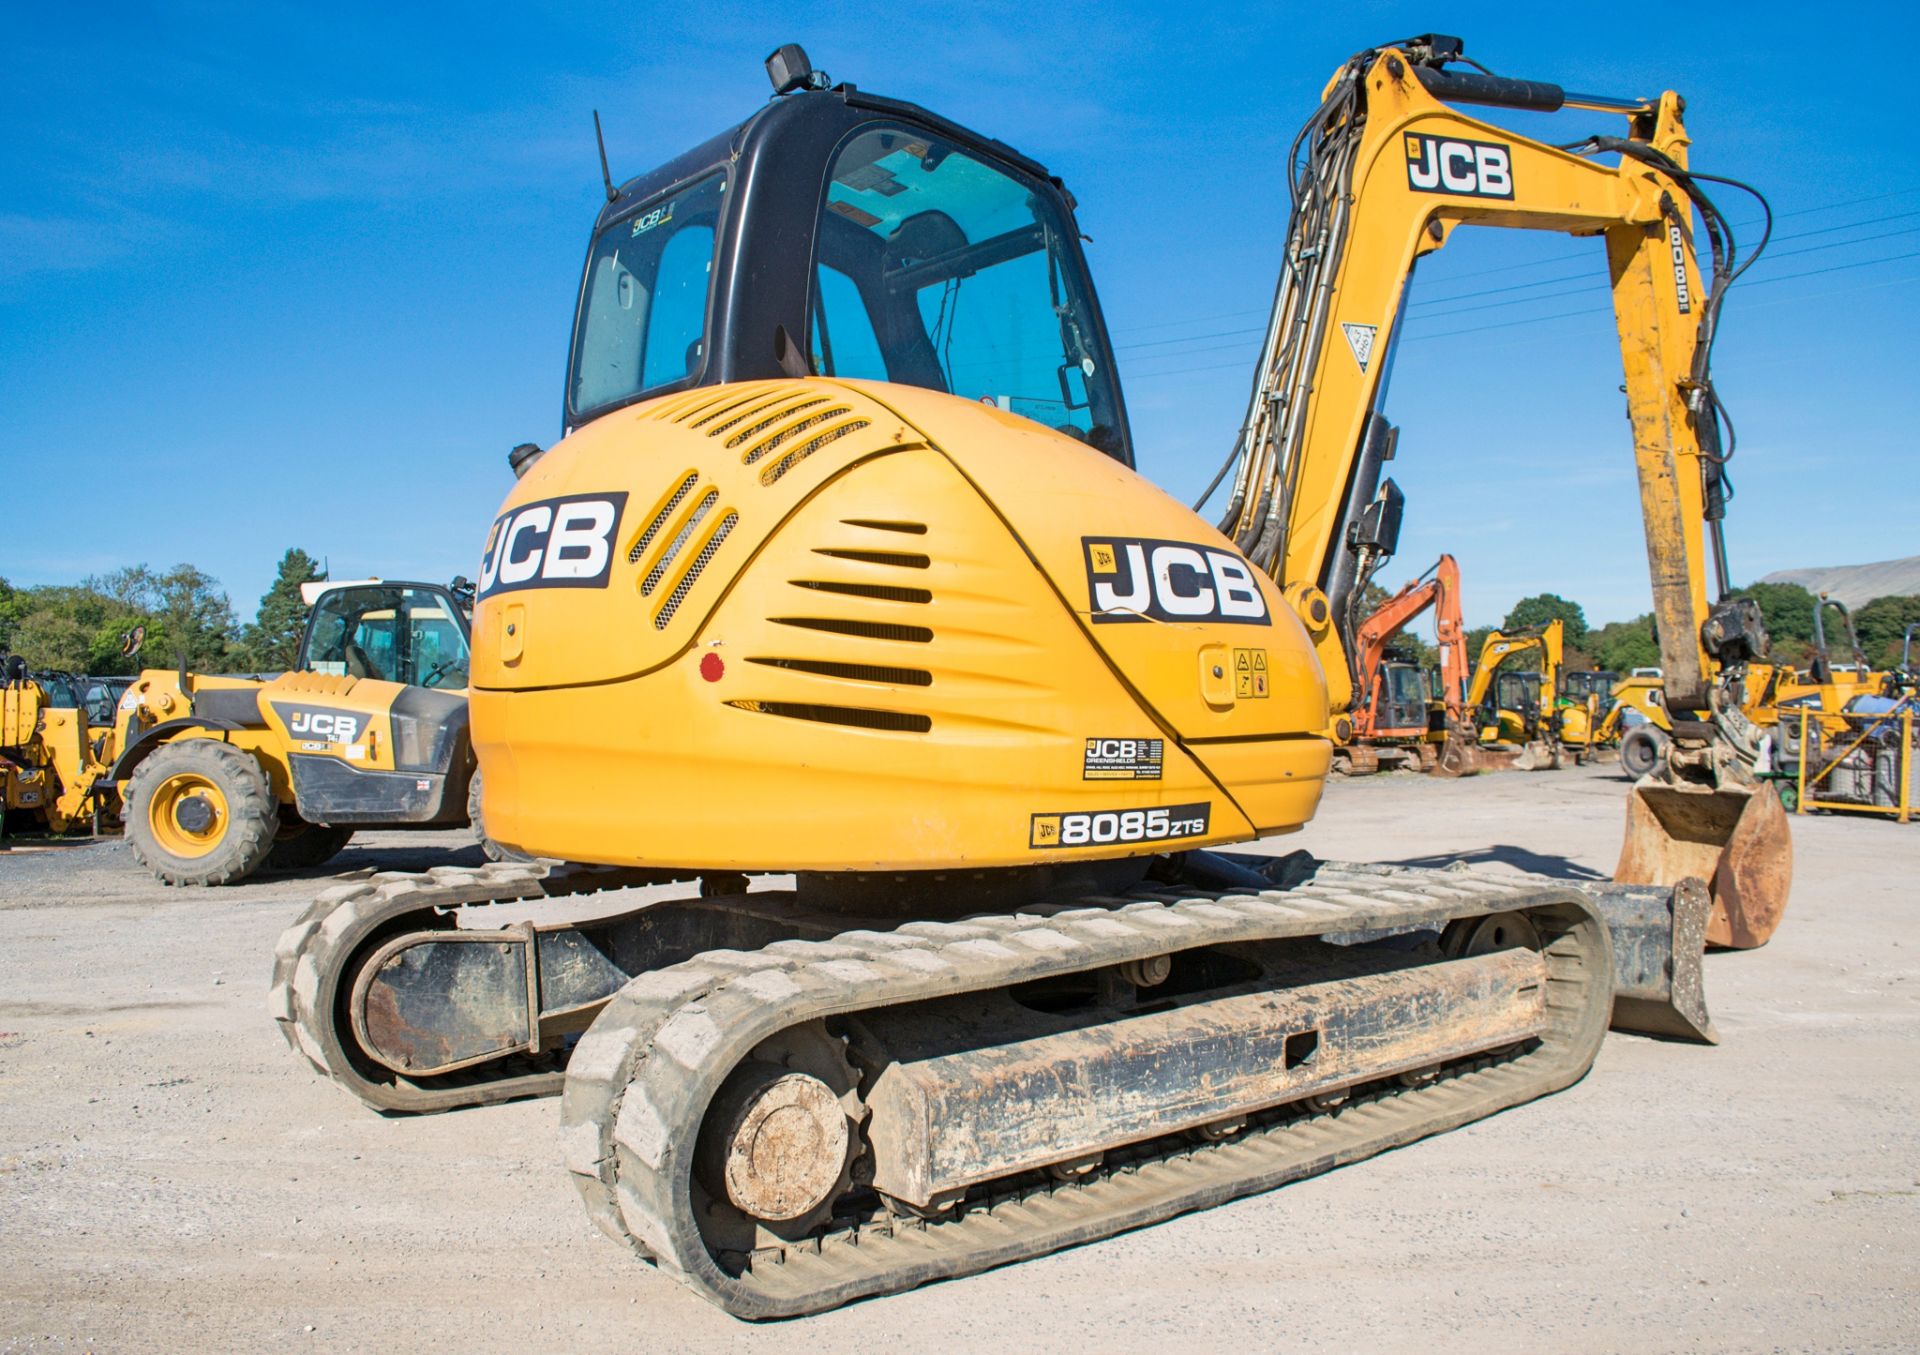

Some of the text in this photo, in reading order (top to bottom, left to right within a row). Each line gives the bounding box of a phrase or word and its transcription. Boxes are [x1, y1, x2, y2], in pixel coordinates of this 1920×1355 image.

[1408, 139, 1512, 195] JCB
[632, 209, 661, 233] JCB
[479, 500, 616, 594] JCB
[1095, 543, 1266, 618] JCB
[291, 713, 357, 735] JCB
[1086, 740, 1137, 758] JCB
